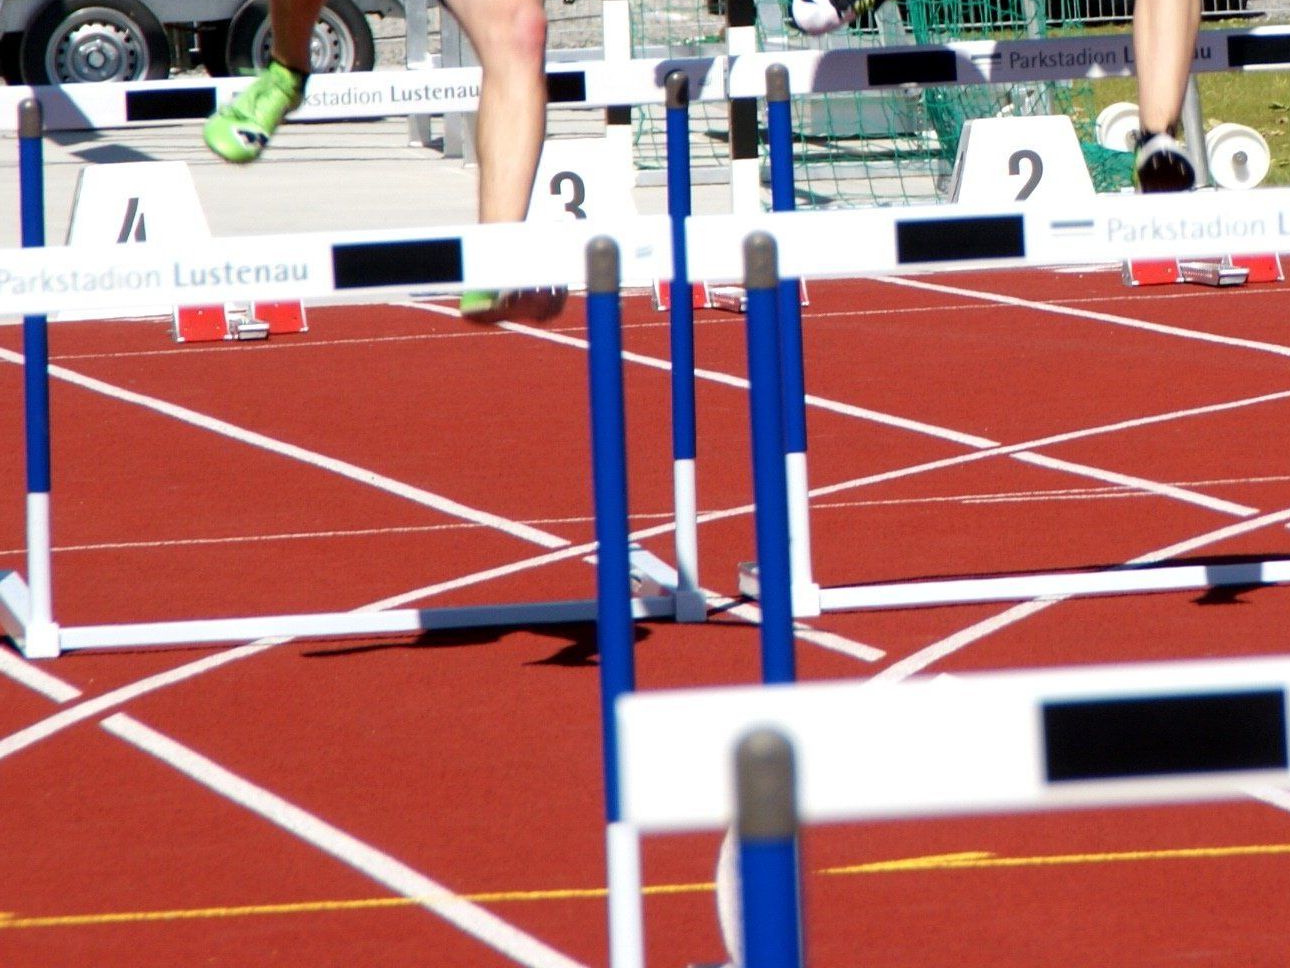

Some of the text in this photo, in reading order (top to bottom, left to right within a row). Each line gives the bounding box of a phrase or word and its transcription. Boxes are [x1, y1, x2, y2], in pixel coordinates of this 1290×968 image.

[1010, 45, 1116, 69] Parkstadion
[390, 85, 481, 103] Lustenau
[1107, 213, 1265, 242] Parkstadion
[172, 261, 310, 288] Lustenau
